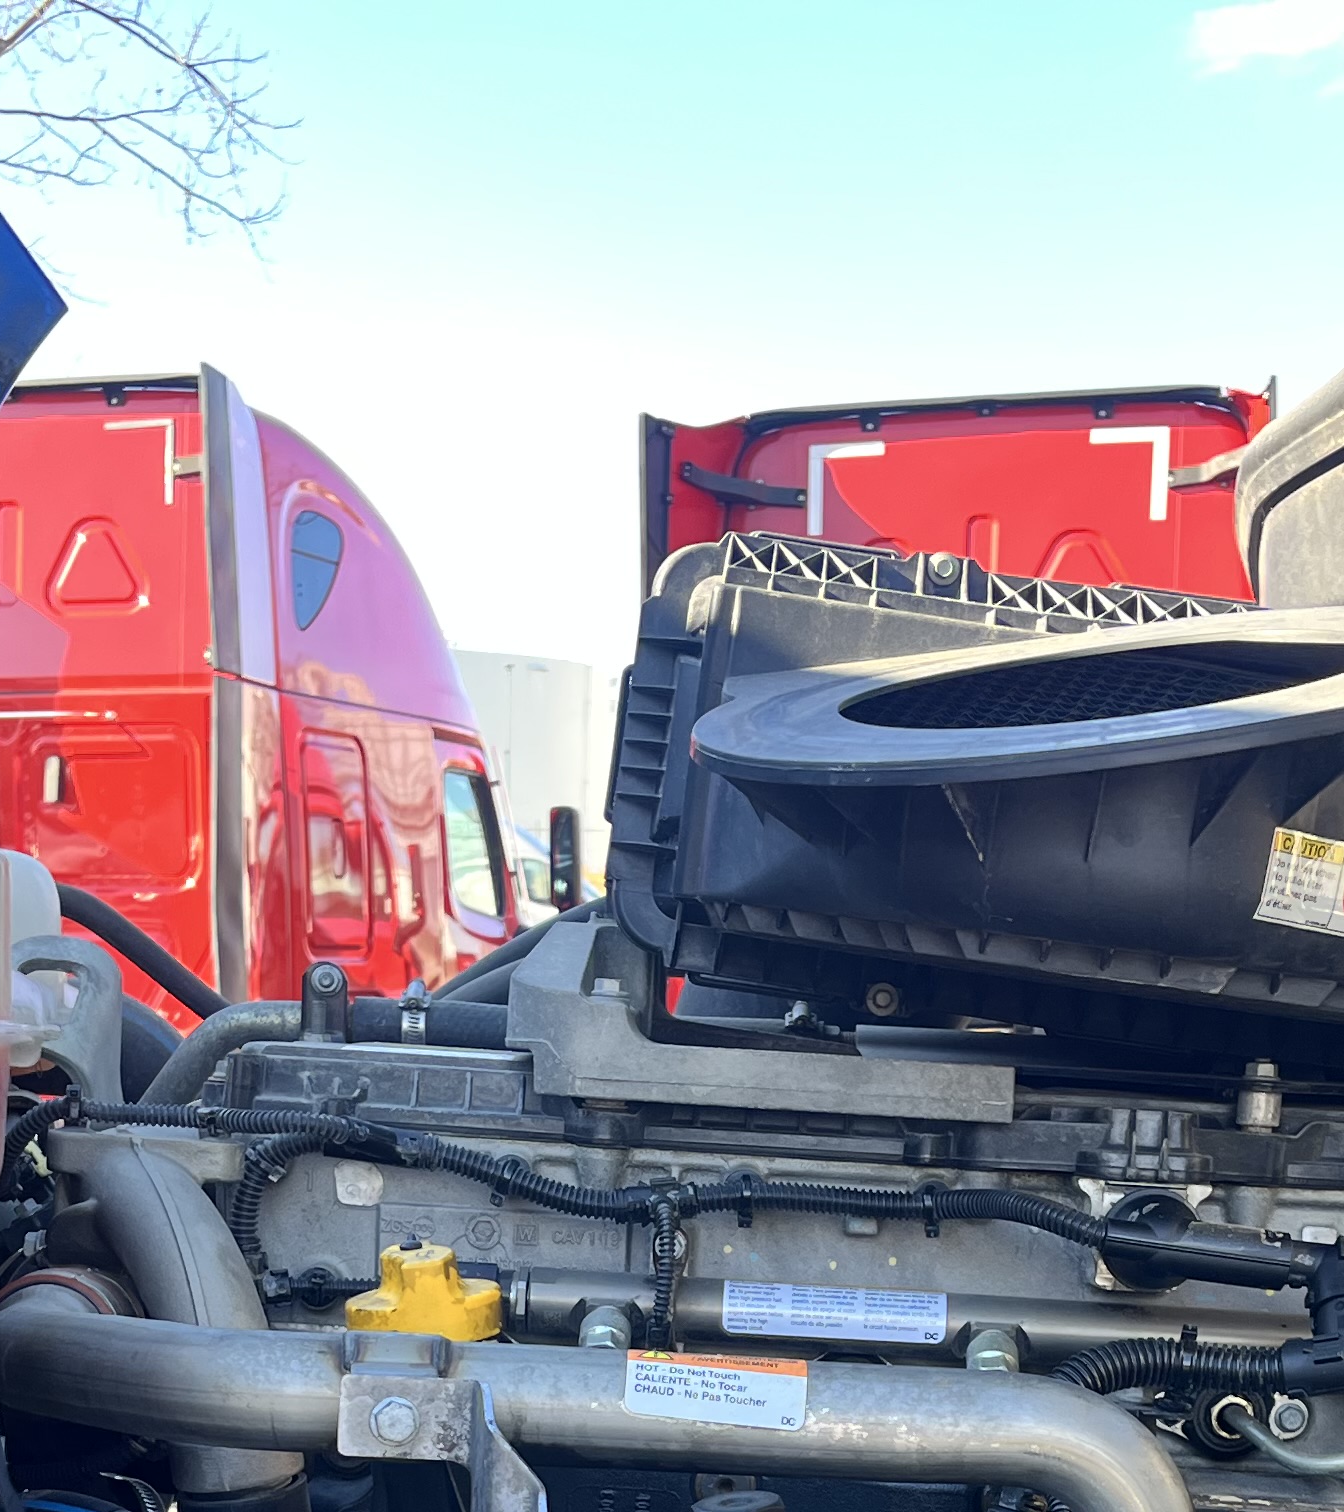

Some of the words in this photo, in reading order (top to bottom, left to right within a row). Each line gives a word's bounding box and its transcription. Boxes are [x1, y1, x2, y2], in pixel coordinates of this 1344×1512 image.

[925, 1332, 938, 1340] DC
[636, 1363, 659, 1372] HOT
[669, 1366, 684, 1375] Do
[687, 1369, 706, 1377] Not
[708, 1370, 741, 1381] Touch
[635, 1373, 691, 1387] CALIENTE
[700, 1380, 716, 1389] No
[719, 1382, 748, 1393] Tocar
[634, 1384, 674, 1396] CHAUD
[684, 1389, 699, 1400] Ne
[702, 1391, 721, 1402] Pas
[723, 1393, 767, 1408] Toucher
[781, 1416, 796, 1427] DC
